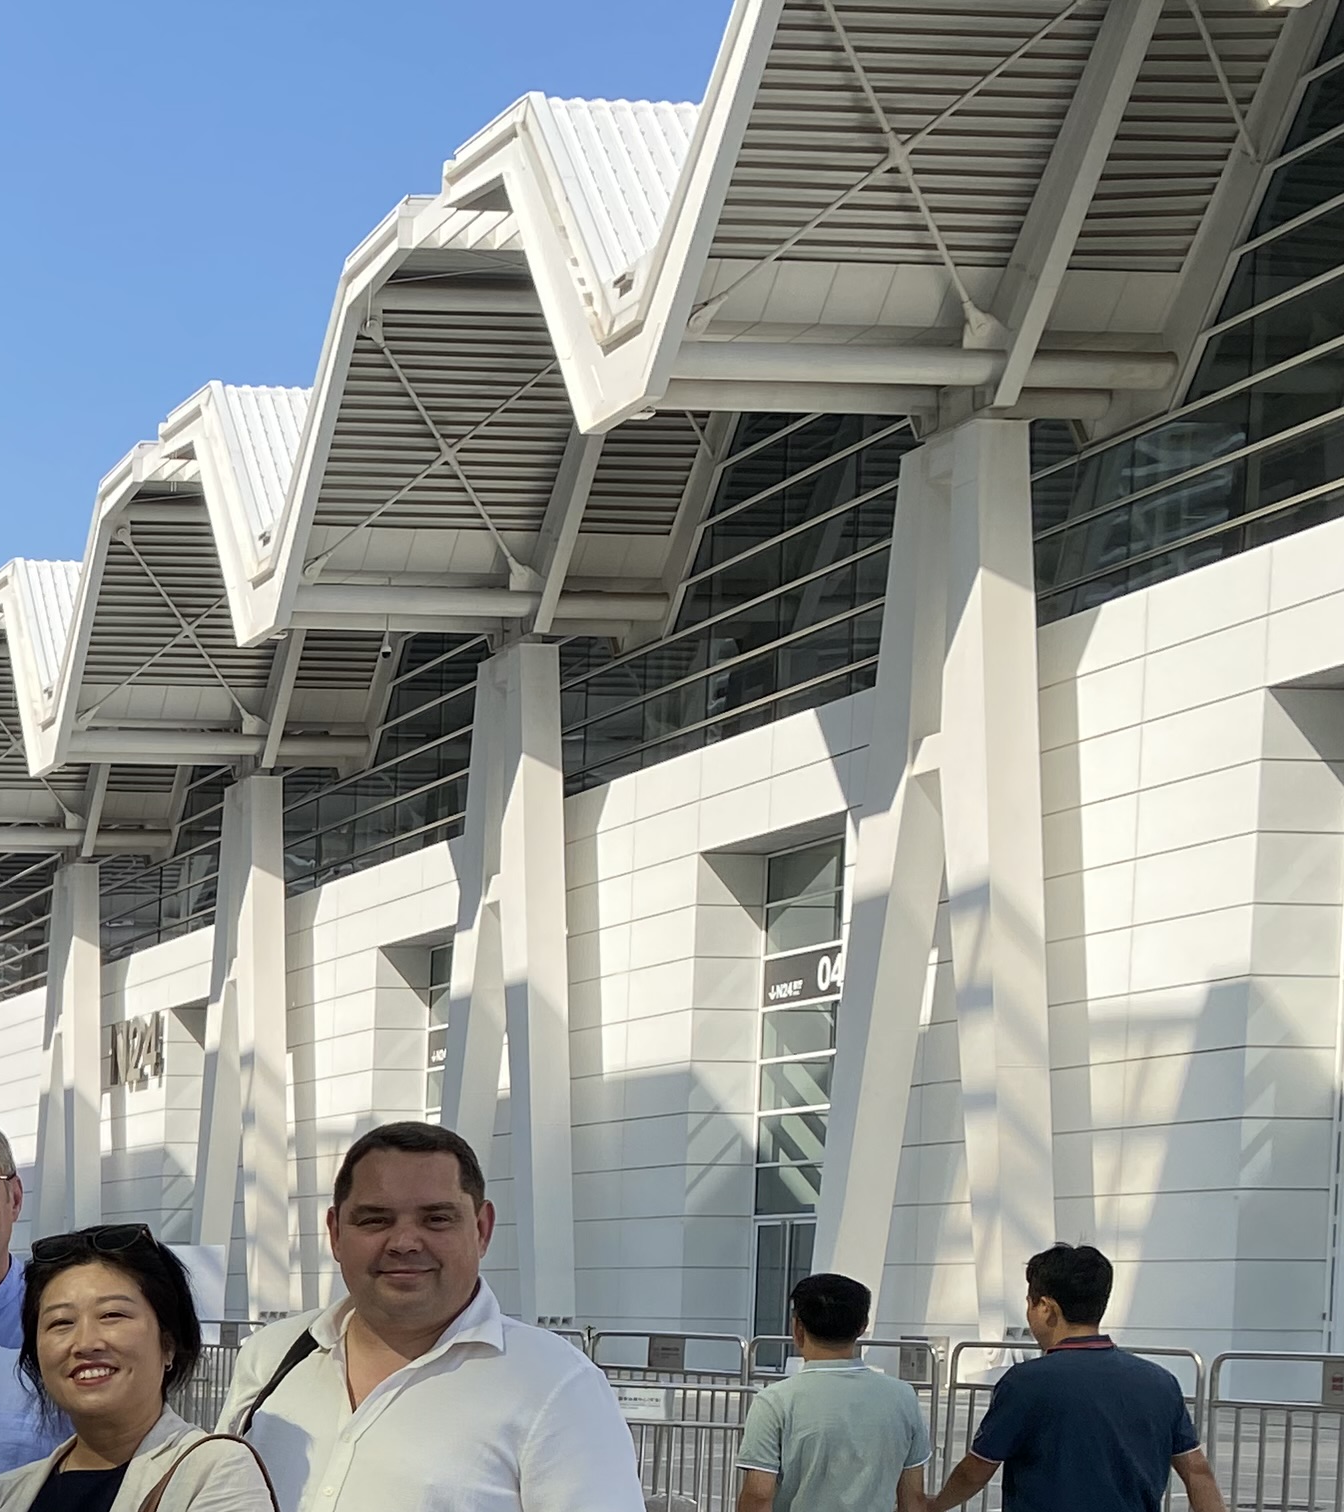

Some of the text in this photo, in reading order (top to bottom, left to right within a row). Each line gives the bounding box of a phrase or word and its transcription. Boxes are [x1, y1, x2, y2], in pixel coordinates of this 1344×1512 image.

[776, 981, 793, 999] N24
[817, 952, 843, 992] 04
[111, 1011, 160, 1086] N24
